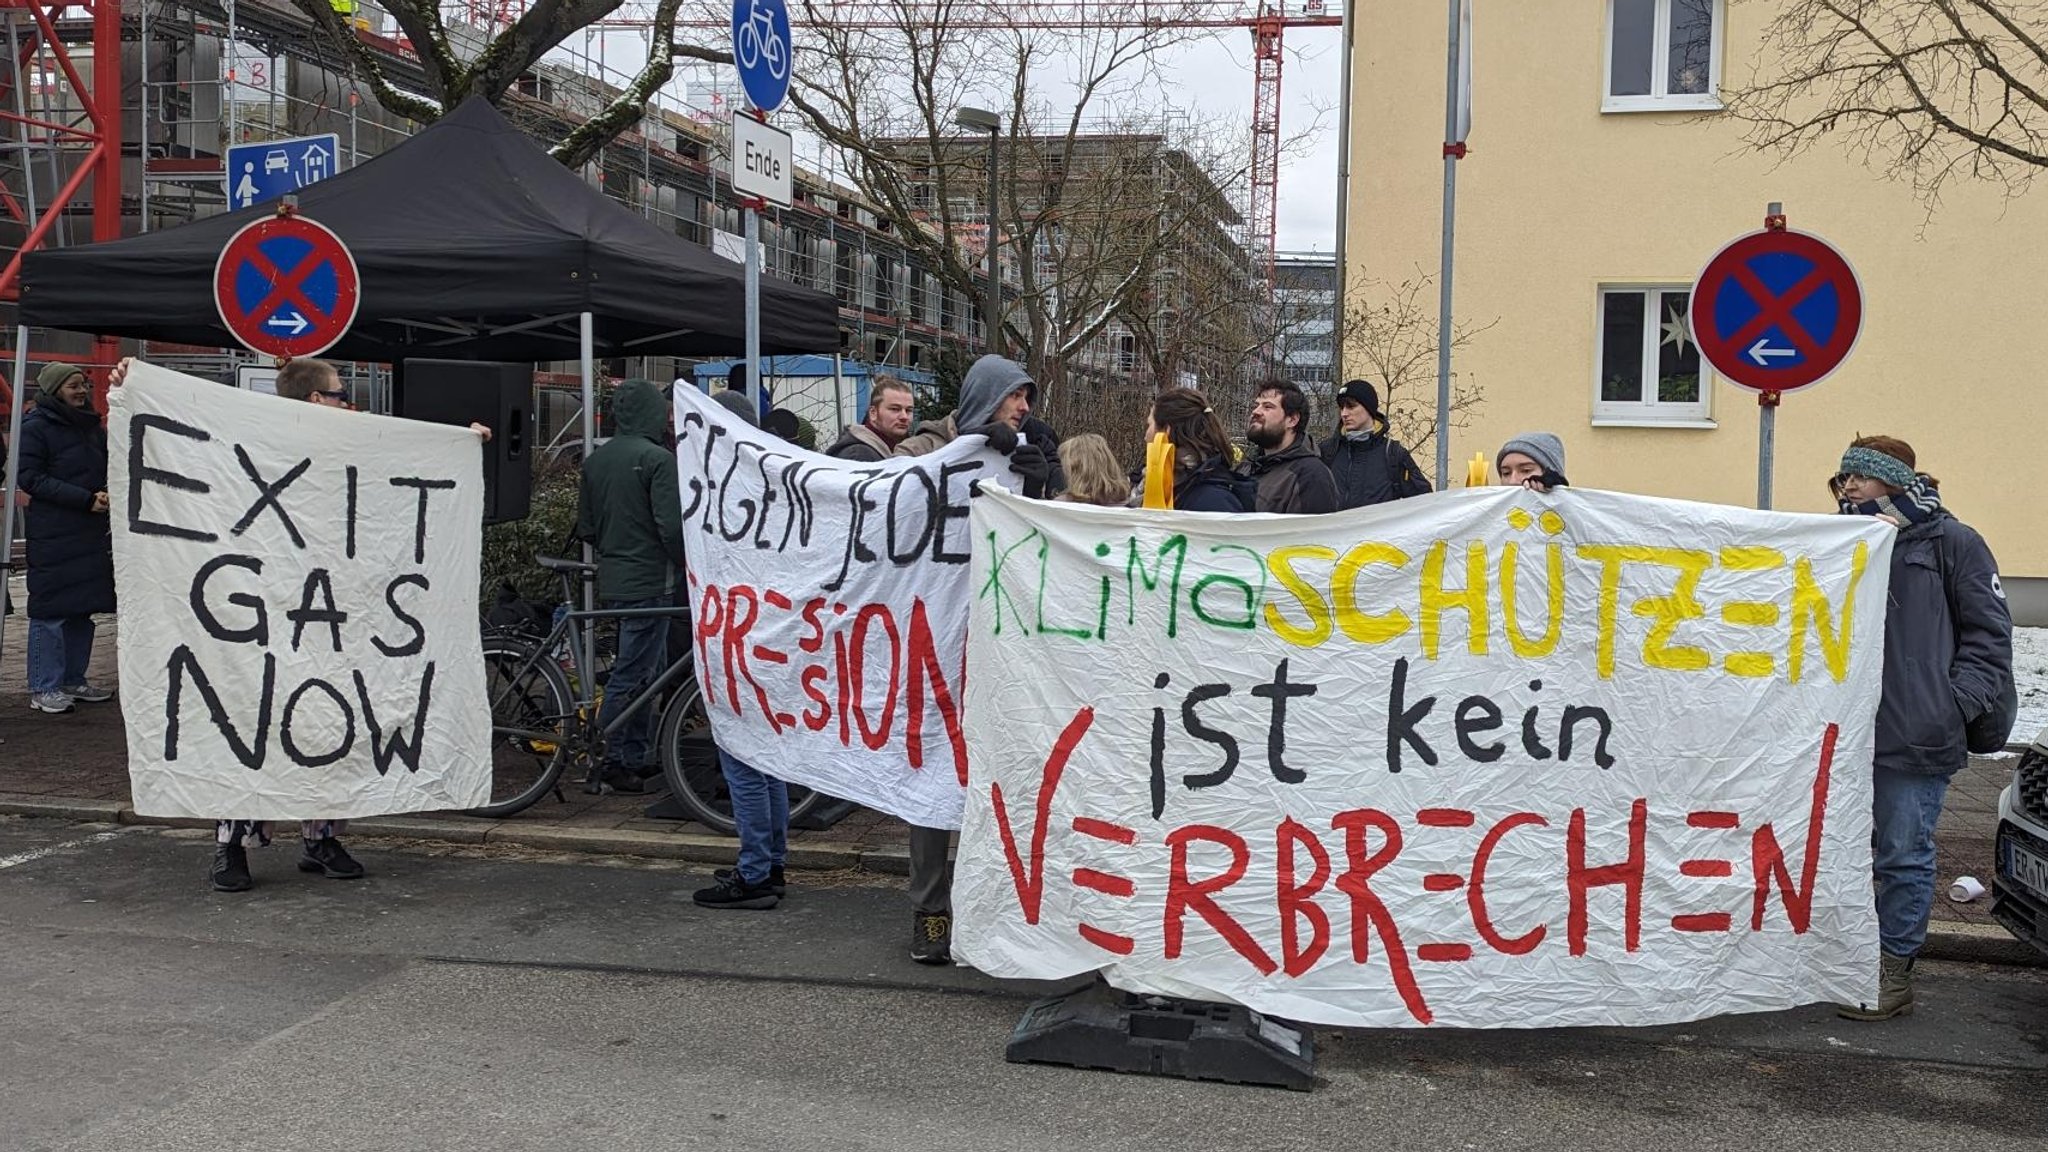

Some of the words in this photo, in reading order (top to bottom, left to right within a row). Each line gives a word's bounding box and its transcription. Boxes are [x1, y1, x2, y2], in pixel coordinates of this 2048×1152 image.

[399, 48, 422, 64] SCHL
[746, 140, 781, 180] Ende
[129, 413, 456, 564] EXIT
[190, 554, 430, 657] GAS
[164, 643, 435, 776] NOW
[1150, 656, 1318, 821] ist
[1387, 656, 1615, 773] kein
[991, 706, 1839, 1026] VERBRECHEN
[2014, 848, 2029, 882] ER
